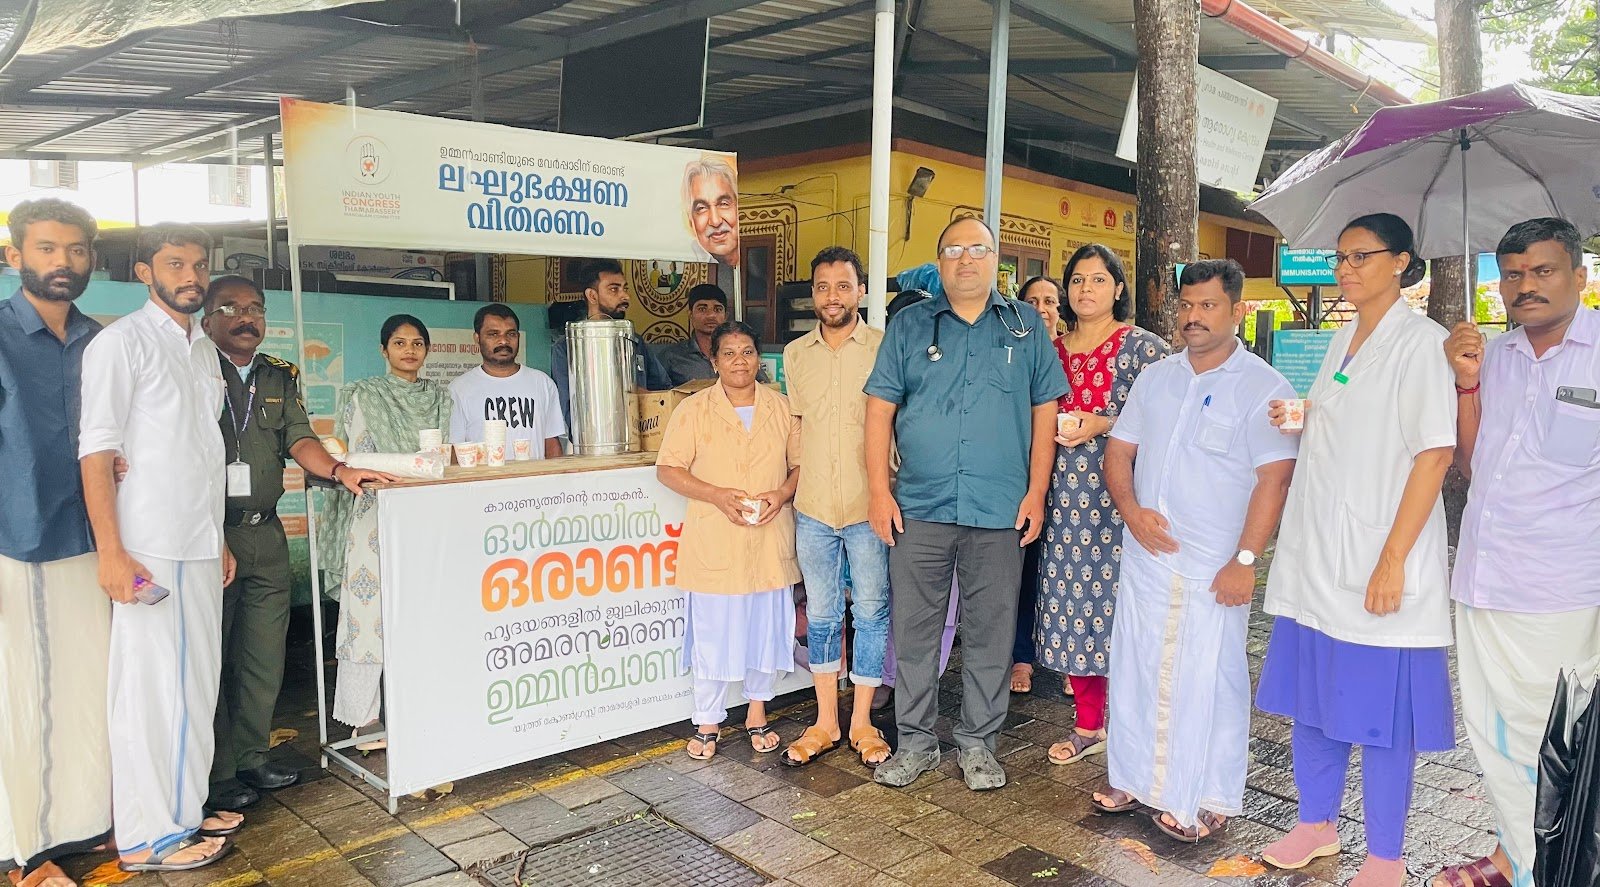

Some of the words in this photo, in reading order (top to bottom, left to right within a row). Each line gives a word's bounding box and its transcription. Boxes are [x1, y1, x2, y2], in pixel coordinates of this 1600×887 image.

[342, 190, 371, 198] INDIAN
[373, 192, 400, 200] YOUTH
[343, 197, 400, 208] CONGRESS
[438, 163, 628, 208] ലഘുഭക്ഷണ
[467, 197, 605, 237] വിതരണം
[484, 396, 535, 429] CREW
[484, 502, 661, 555] ഓർമ്മയിൽ
[484, 605, 601, 642] ഹൃദയങ്ങളിൽ
[606, 596, 685, 621] ജ്വലിക്കുന്ന
[486, 616, 685, 672] അമരസ്മരണ
